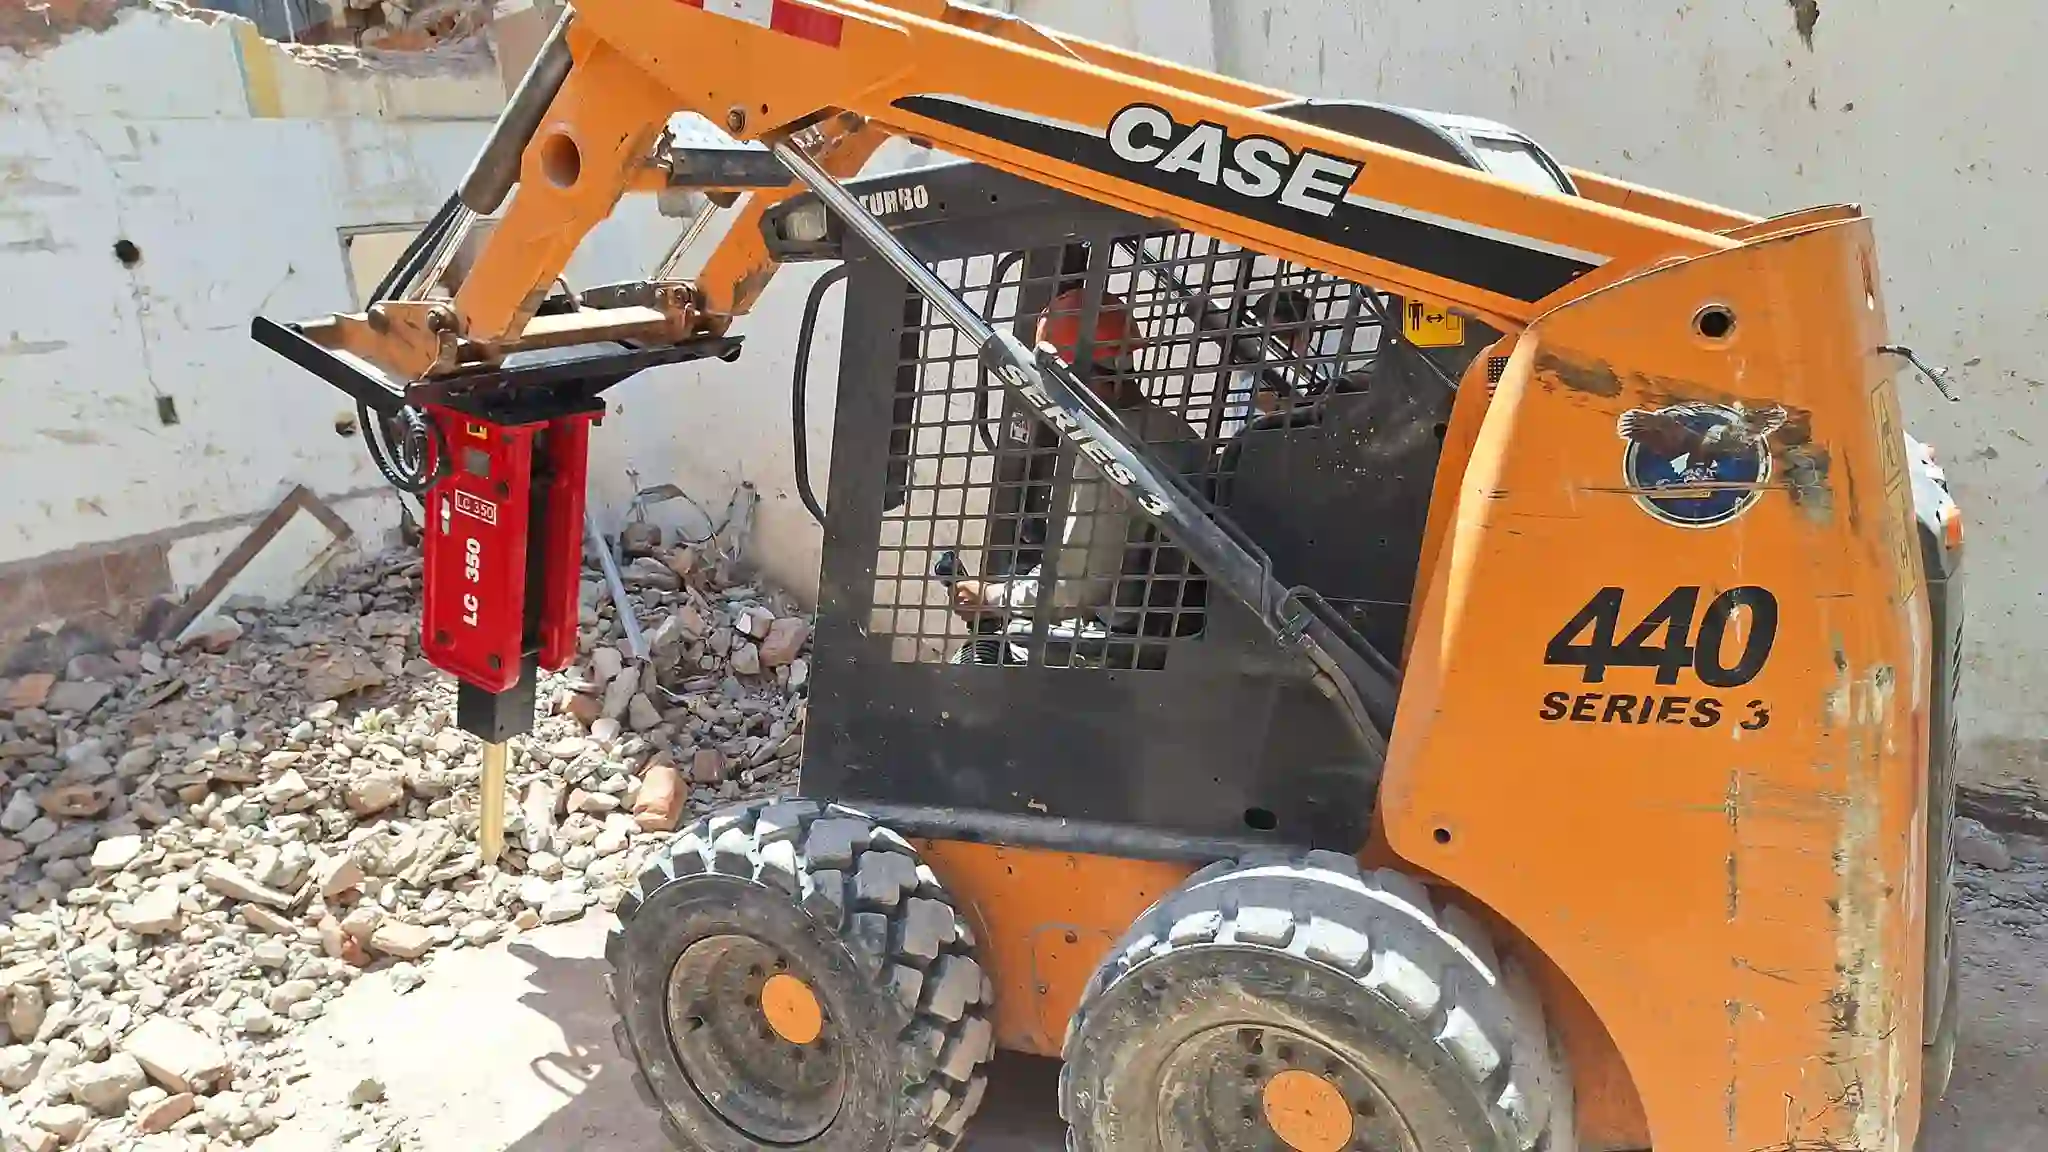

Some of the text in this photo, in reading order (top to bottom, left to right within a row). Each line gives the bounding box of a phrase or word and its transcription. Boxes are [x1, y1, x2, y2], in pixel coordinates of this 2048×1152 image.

[858, 184, 929, 216] TURBO
[1107, 104, 1361, 217] CASE
[998, 364, 1169, 517] SERIES 3
[457, 494, 494, 519] LC 350
[463, 538, 481, 627] LC 350
[1543, 585, 1779, 688] 440
[1539, 691, 1770, 730] SERIES 3
